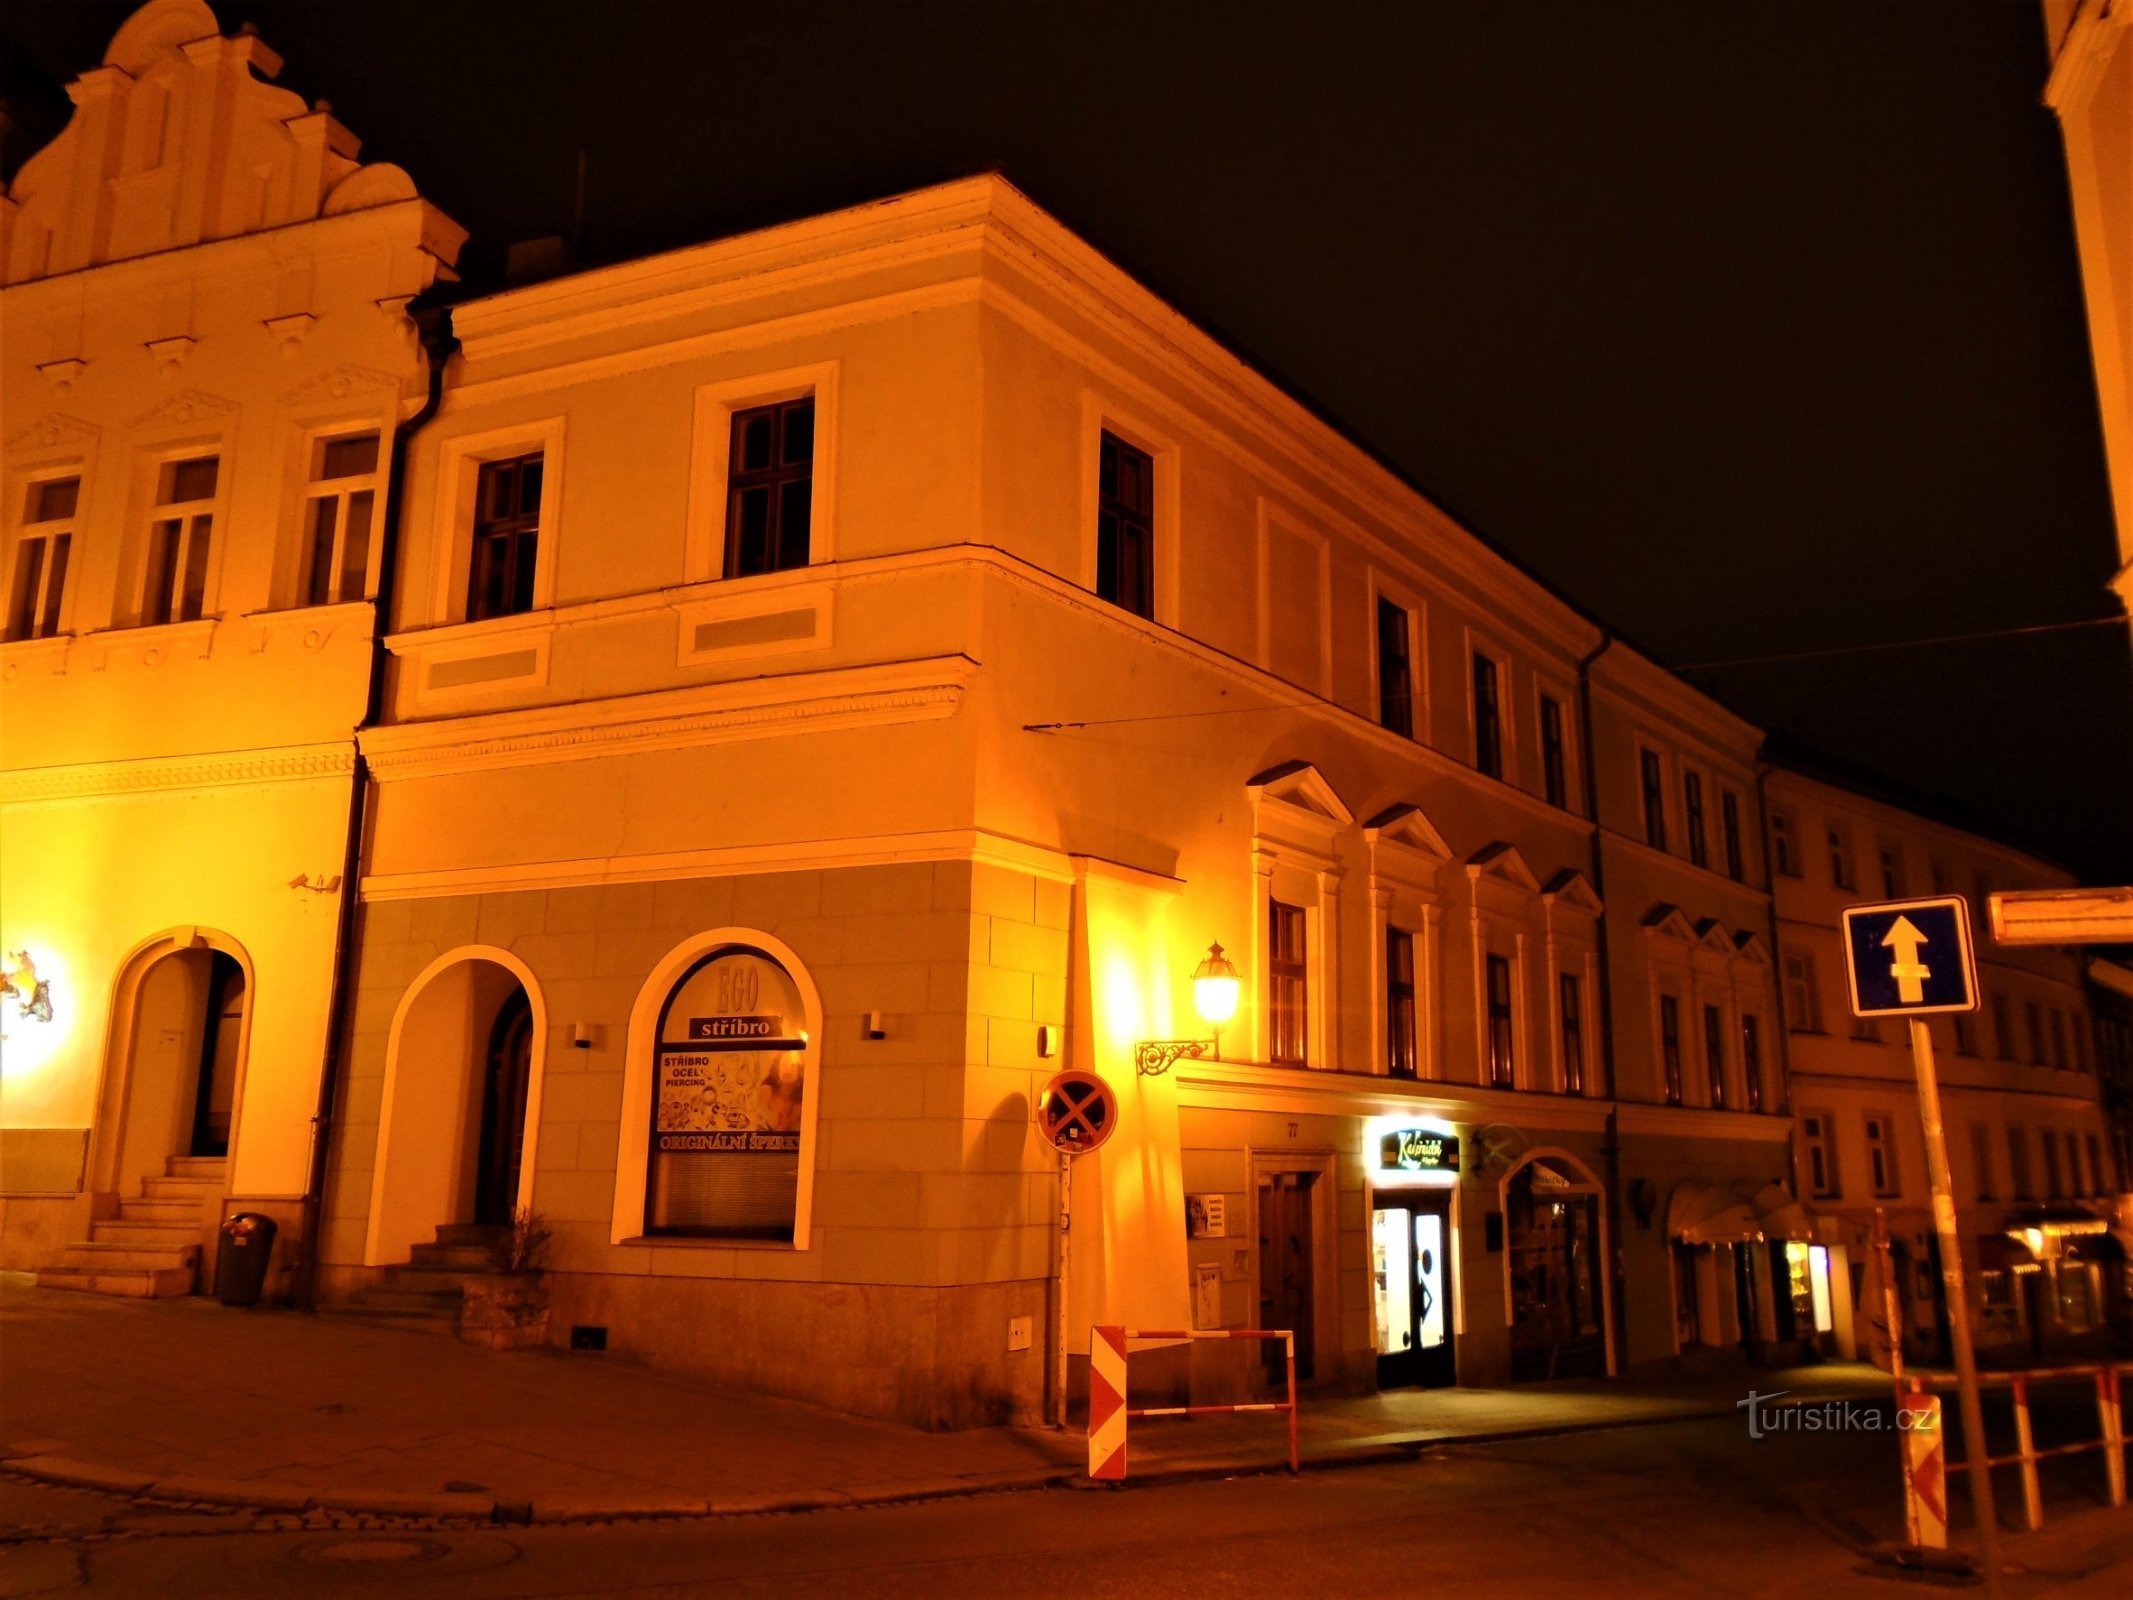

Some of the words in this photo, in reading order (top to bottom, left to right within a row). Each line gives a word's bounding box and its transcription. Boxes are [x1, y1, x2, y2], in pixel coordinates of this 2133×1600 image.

[716, 966, 759, 1014] EGO
[701, 1019, 770, 1036] stříbro
[664, 1055, 709, 1067] STŘÍBRO
[665, 1078, 706, 1087] PIERCING
[1287, 1122, 1298, 1138] 77
[660, 1132, 747, 1150] ORIGINÁLNÍ
